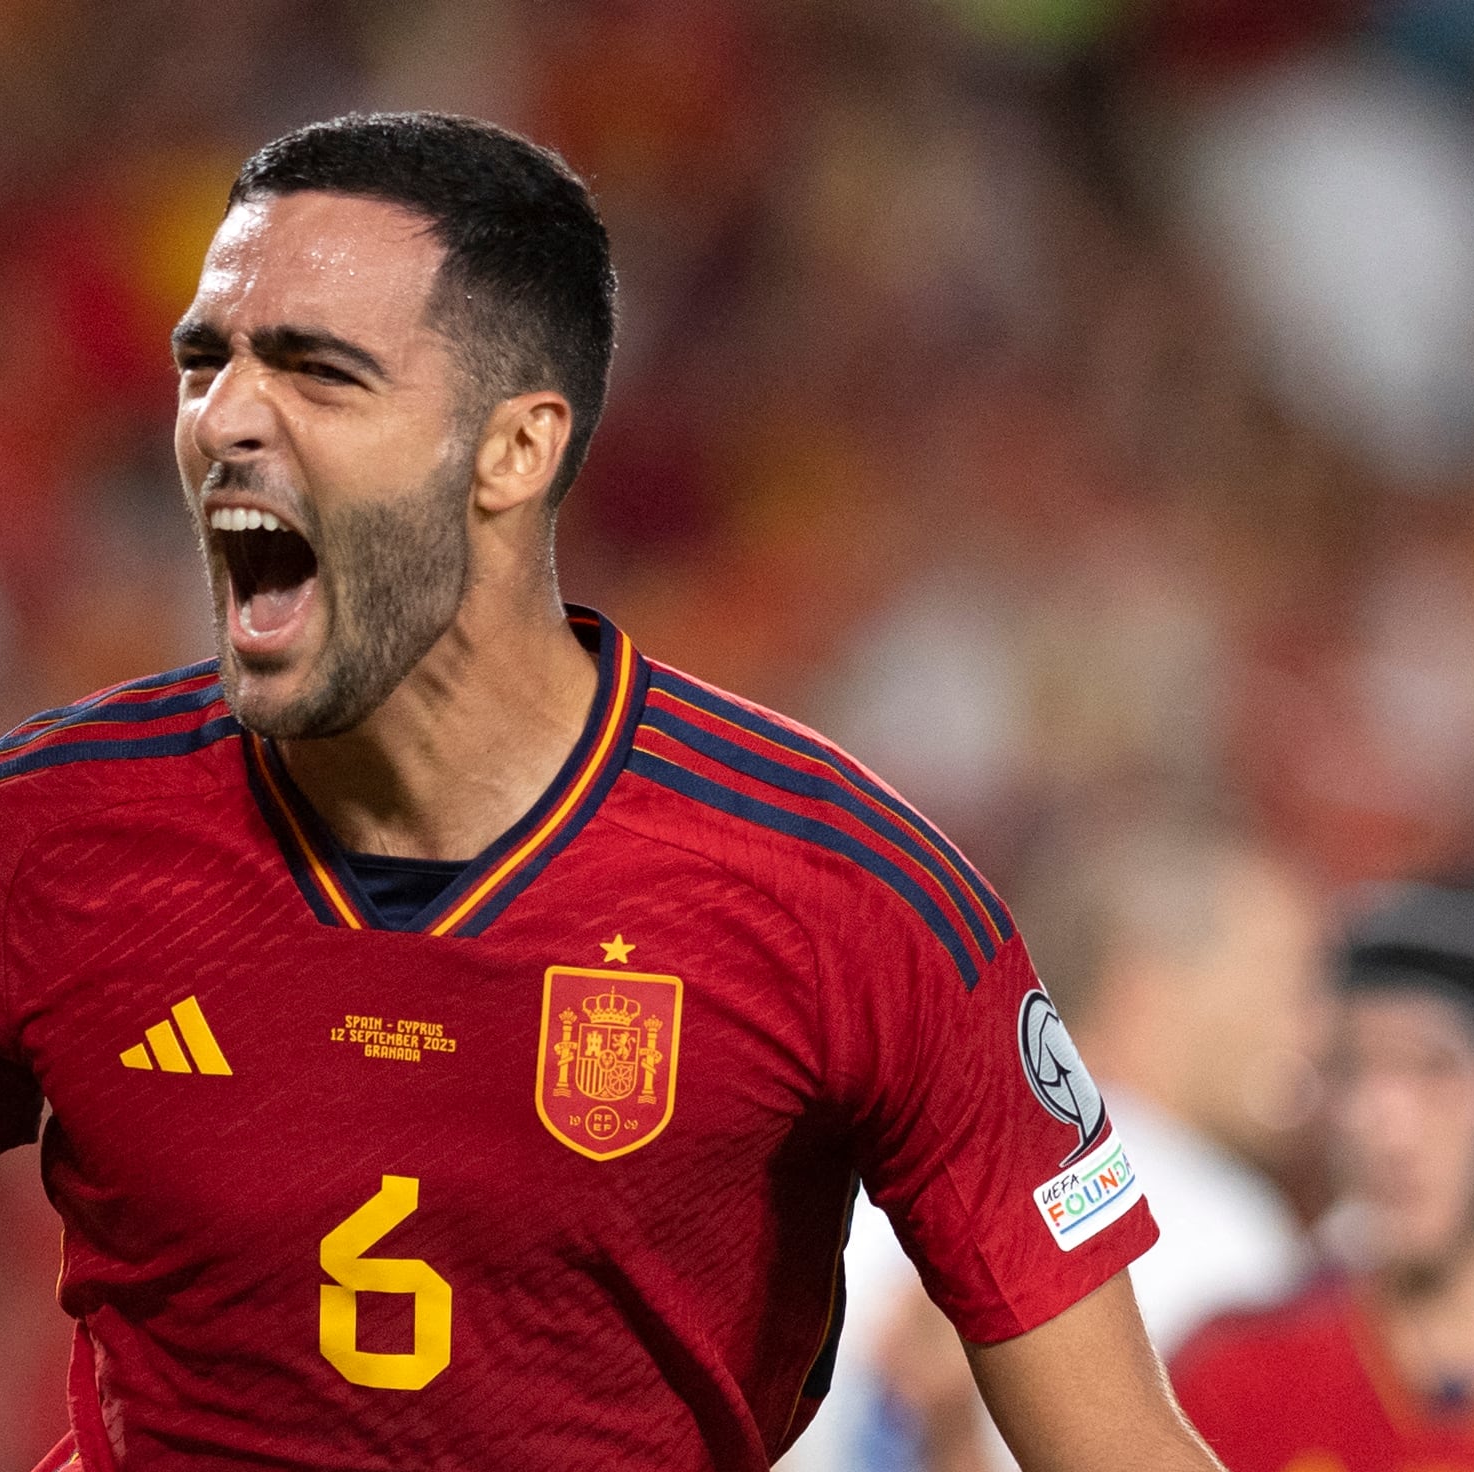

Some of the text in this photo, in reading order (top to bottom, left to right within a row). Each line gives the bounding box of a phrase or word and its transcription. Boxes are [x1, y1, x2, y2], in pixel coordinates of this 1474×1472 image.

[345, 1015, 383, 1030] SPAIN
[397, 1019, 443, 1037] CYPRUS
[330, 1028, 456, 1052] 12 SEPTEMBER 2023
[364, 1044, 421, 1062] GRANADA
[1042, 1174, 1079, 1204] UEFA
[320, 1174, 452, 1390] 6
